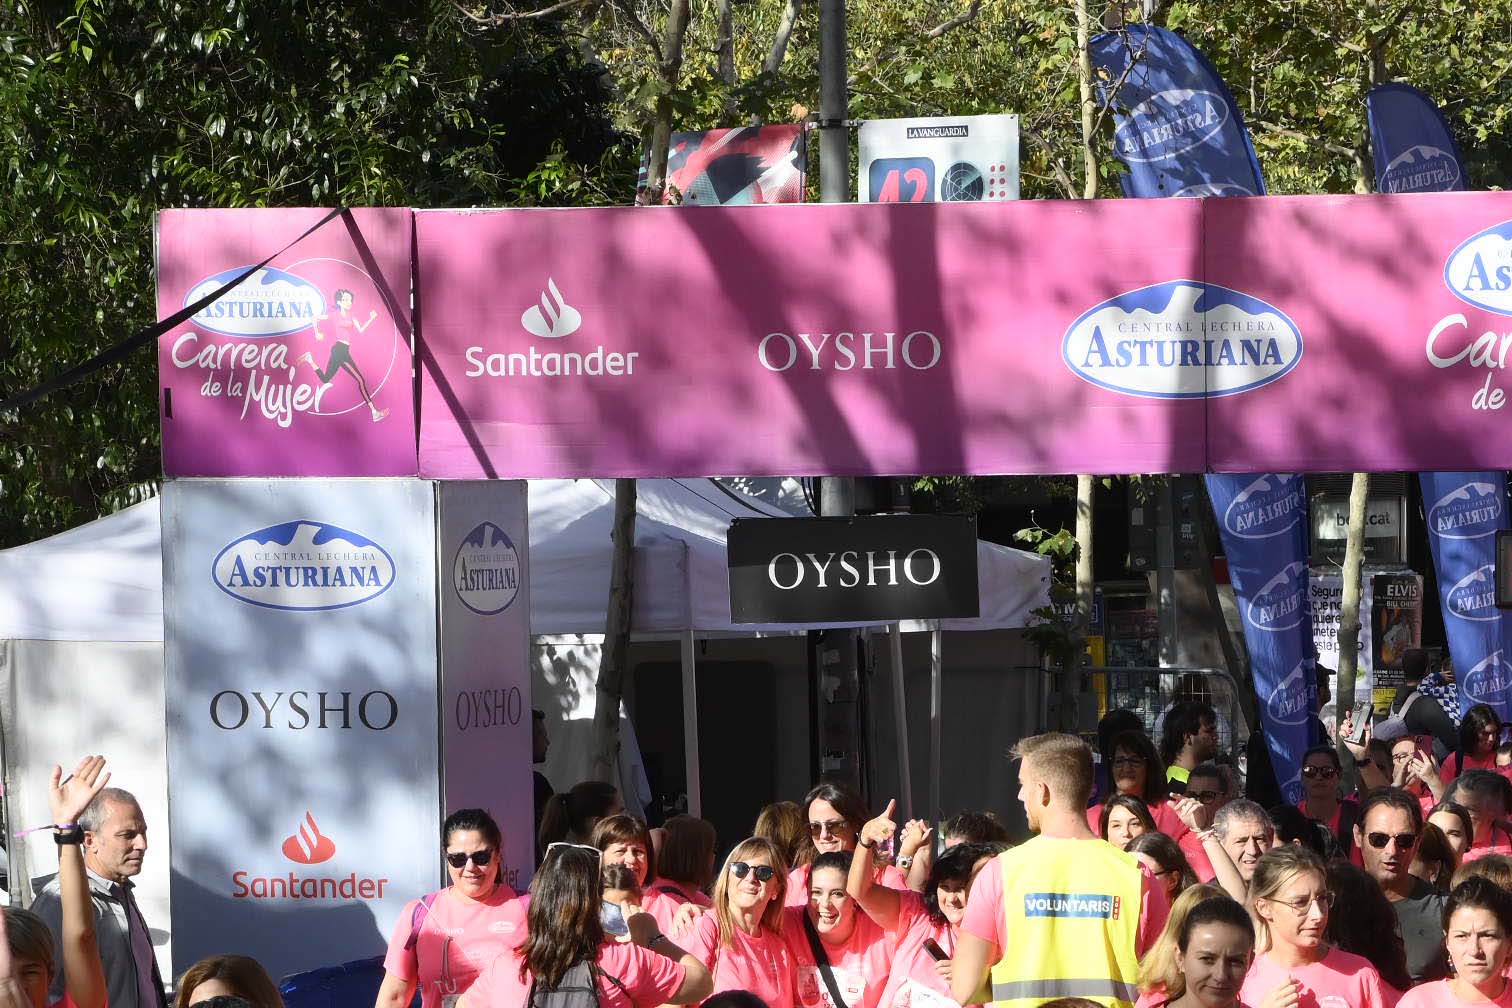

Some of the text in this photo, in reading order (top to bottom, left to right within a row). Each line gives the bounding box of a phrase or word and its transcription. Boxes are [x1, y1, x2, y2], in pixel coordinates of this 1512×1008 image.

[918, 127, 967, 137] VANGUARDIA
[1118, 320, 1276, 334] CENTRAL LECHERA
[171, 332, 289, 370] Carrera
[465, 345, 638, 376] Santander
[758, 331, 942, 373] OYSHO
[1081, 325, 1285, 369] ASTURIANA
[200, 366, 333, 428] de la Mujer
[1471, 374, 1506, 411] de
[226, 555, 382, 589] ASTURIANA
[254, 552, 377, 561] CENTRAL LECHERA
[768, 548, 942, 590] OYSHO
[458, 556, 518, 592] ASTURIANA
[1311, 585, 1343, 598] Segur
[1387, 584, 1417, 597] ELVIS
[1312, 614, 1343, 626] quiere
[1313, 626, 1338, 637] mete
[209, 690, 399, 730] OYSHO
[456, 686, 521, 732] OYSHO
[232, 871, 389, 898] Santander
[1026, 898, 1110, 913] VOLUNTARIS
